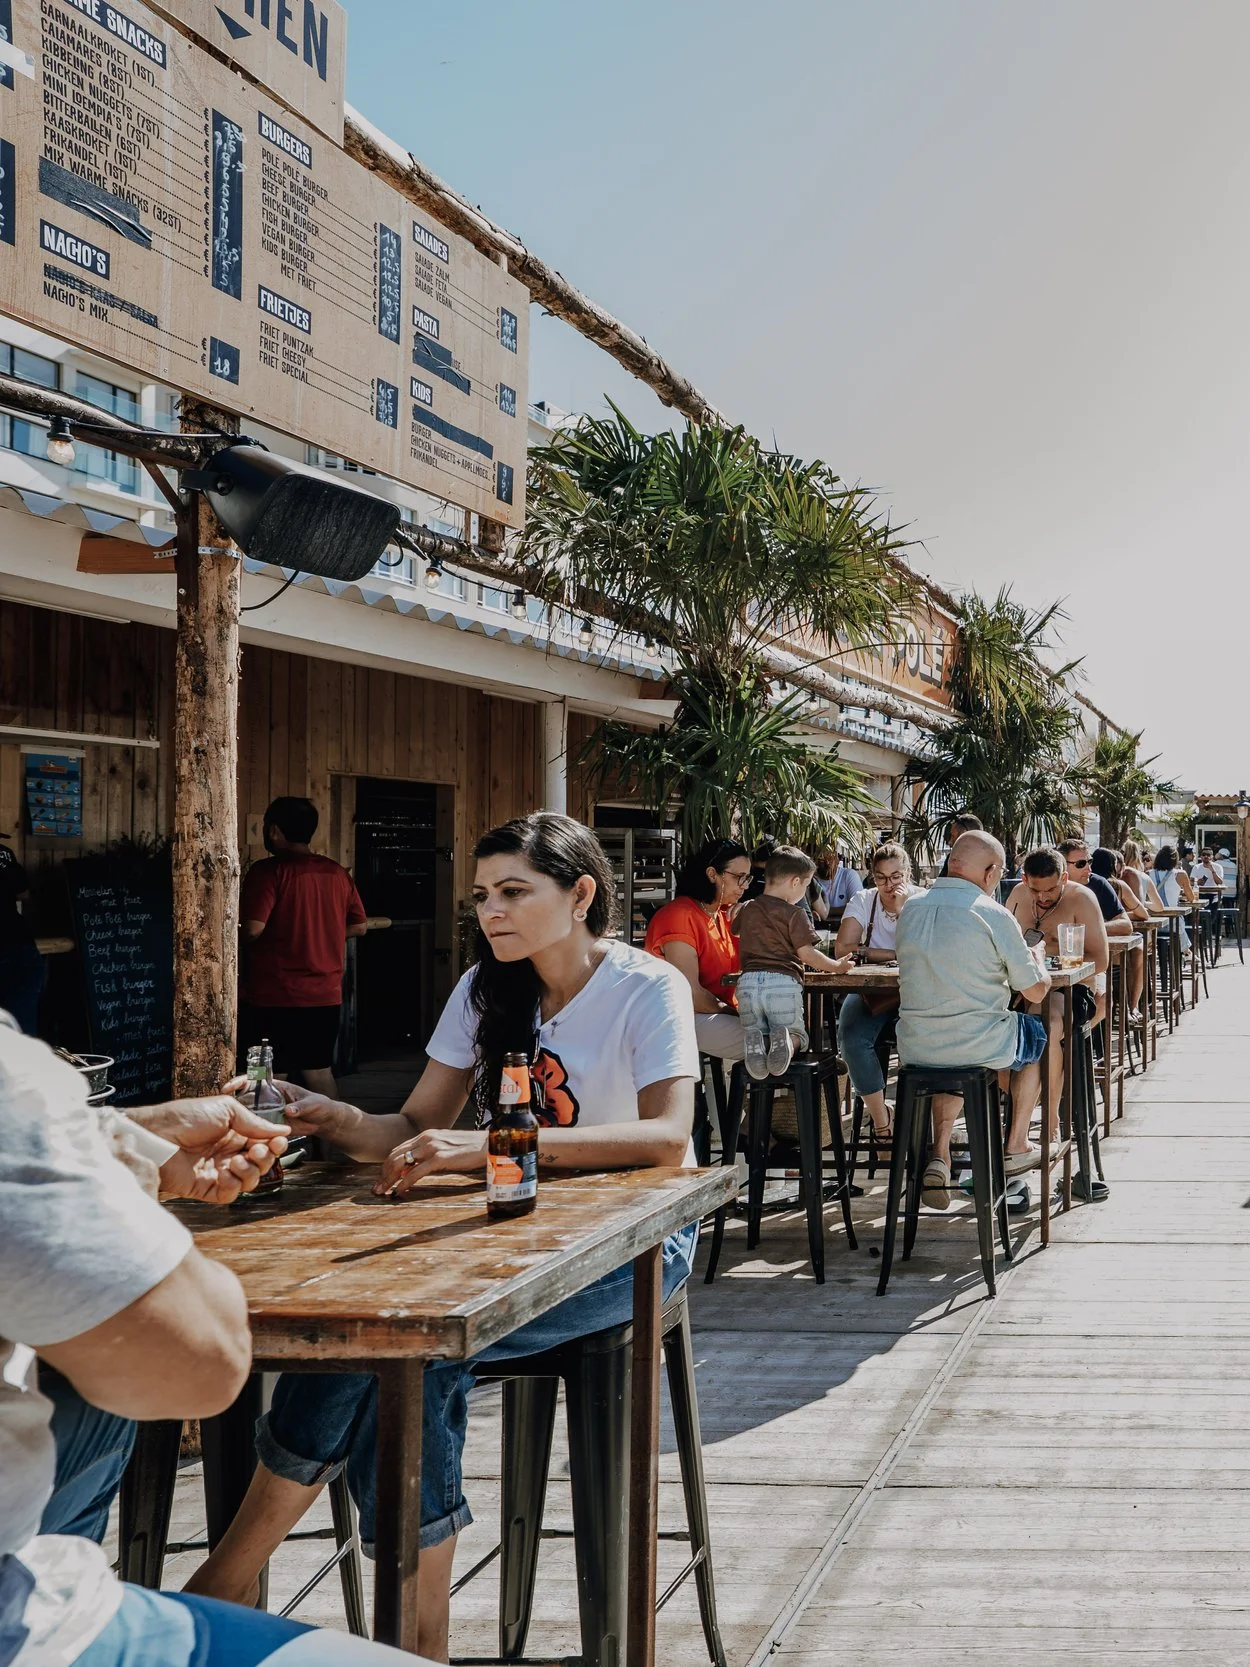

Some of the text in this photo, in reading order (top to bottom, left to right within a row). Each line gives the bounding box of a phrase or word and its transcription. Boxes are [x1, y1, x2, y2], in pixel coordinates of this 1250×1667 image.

[41, 0, 128, 67] GARNAALKROKET
[132, 59, 155, 88] (1ST)
[41, 18, 102, 67] CALAMARES
[107, 60, 132, 89] (8ST)
[106, 8, 163, 64] SNACKS
[245, 0, 328, 82] EN
[42, 35, 94, 79] KIBBELING
[99, 71, 125, 100] (8ST)
[42, 54, 84, 91] CHICKEN
[89, 86, 132, 121] NUGGETS
[137, 112, 160, 139] (7ST)
[42, 71, 67, 97] MINI
[73, 90, 122, 131] LOEMPIA'S
[127, 122, 150, 149] (7ST)
[43, 89, 112, 142] BITTERBALLEN
[116, 133, 141, 160] (6ST)
[43, 107, 109, 157] KAASKROKET
[114, 149, 137, 174] (1ST)
[261, 116, 310, 165] BURGERS
[44, 125, 100, 169] FRIKANDEL
[104, 160, 128, 186] (1ST)
[44, 143, 64, 167] MIX
[69, 157, 108, 191] WARME
[112, 183, 148, 214] SNACKS
[153, 204, 182, 233] (32ST)
[261, 162, 287, 188] CHEESE
[290, 183, 316, 208] BURGER
[262, 177, 280, 197] BEEF
[282, 191, 309, 216] BURGER
[302, 175, 328, 201] BURGER
[261, 192, 291, 220] CHICKEN
[293, 211, 319, 237] BURGER
[262, 207, 278, 226] FISH
[281, 220, 308, 245] BURGER
[43, 225, 107, 275] NACHO'S
[261, 237, 278, 256] KIDS
[281, 248, 308, 273] BURGER
[262, 222, 286, 246] VEGAN
[288, 238, 315, 263] BURGER
[414, 225, 448, 262] SALADES
[280, 263, 295, 281] MET
[298, 272, 317, 293] FRIET
[415, 252, 434, 273] SALADE
[435, 266, 450, 283] ZALM
[415, 265, 433, 286] SALADE
[435, 278, 448, 294] FETA
[260, 288, 309, 331] FRIETJES
[415, 278, 433, 298] SALADE
[435, 291, 453, 310] VEGAN
[43, 281, 85, 312] NACHO'S
[90, 303, 108, 323] MIX
[213, 357, 230, 376] 18
[260, 321, 280, 340] FRIET
[282, 332, 314, 358] PUNTZAK
[414, 308, 438, 338] PASTA
[259, 350, 279, 370] FRIET
[281, 361, 309, 384] SPECIAL
[260, 335, 280, 355] FRIET
[282, 347, 307, 369] CHEESY
[412, 380, 431, 404] KIDS
[411, 422, 431, 439] BURGER
[410, 435, 431, 452] CHICKEN
[434, 445, 456, 465] NUGGETS
[461, 459, 488, 479] APPELMOES
[410, 447, 438, 468] FRIKANDEL
[88, 943, 111, 960] Beef
[92, 961, 128, 975] Chicken
[94, 976, 156, 994] Fish burger
[96, 999, 122, 1015] Vegan
[100, 1016, 120, 1031] Kids
